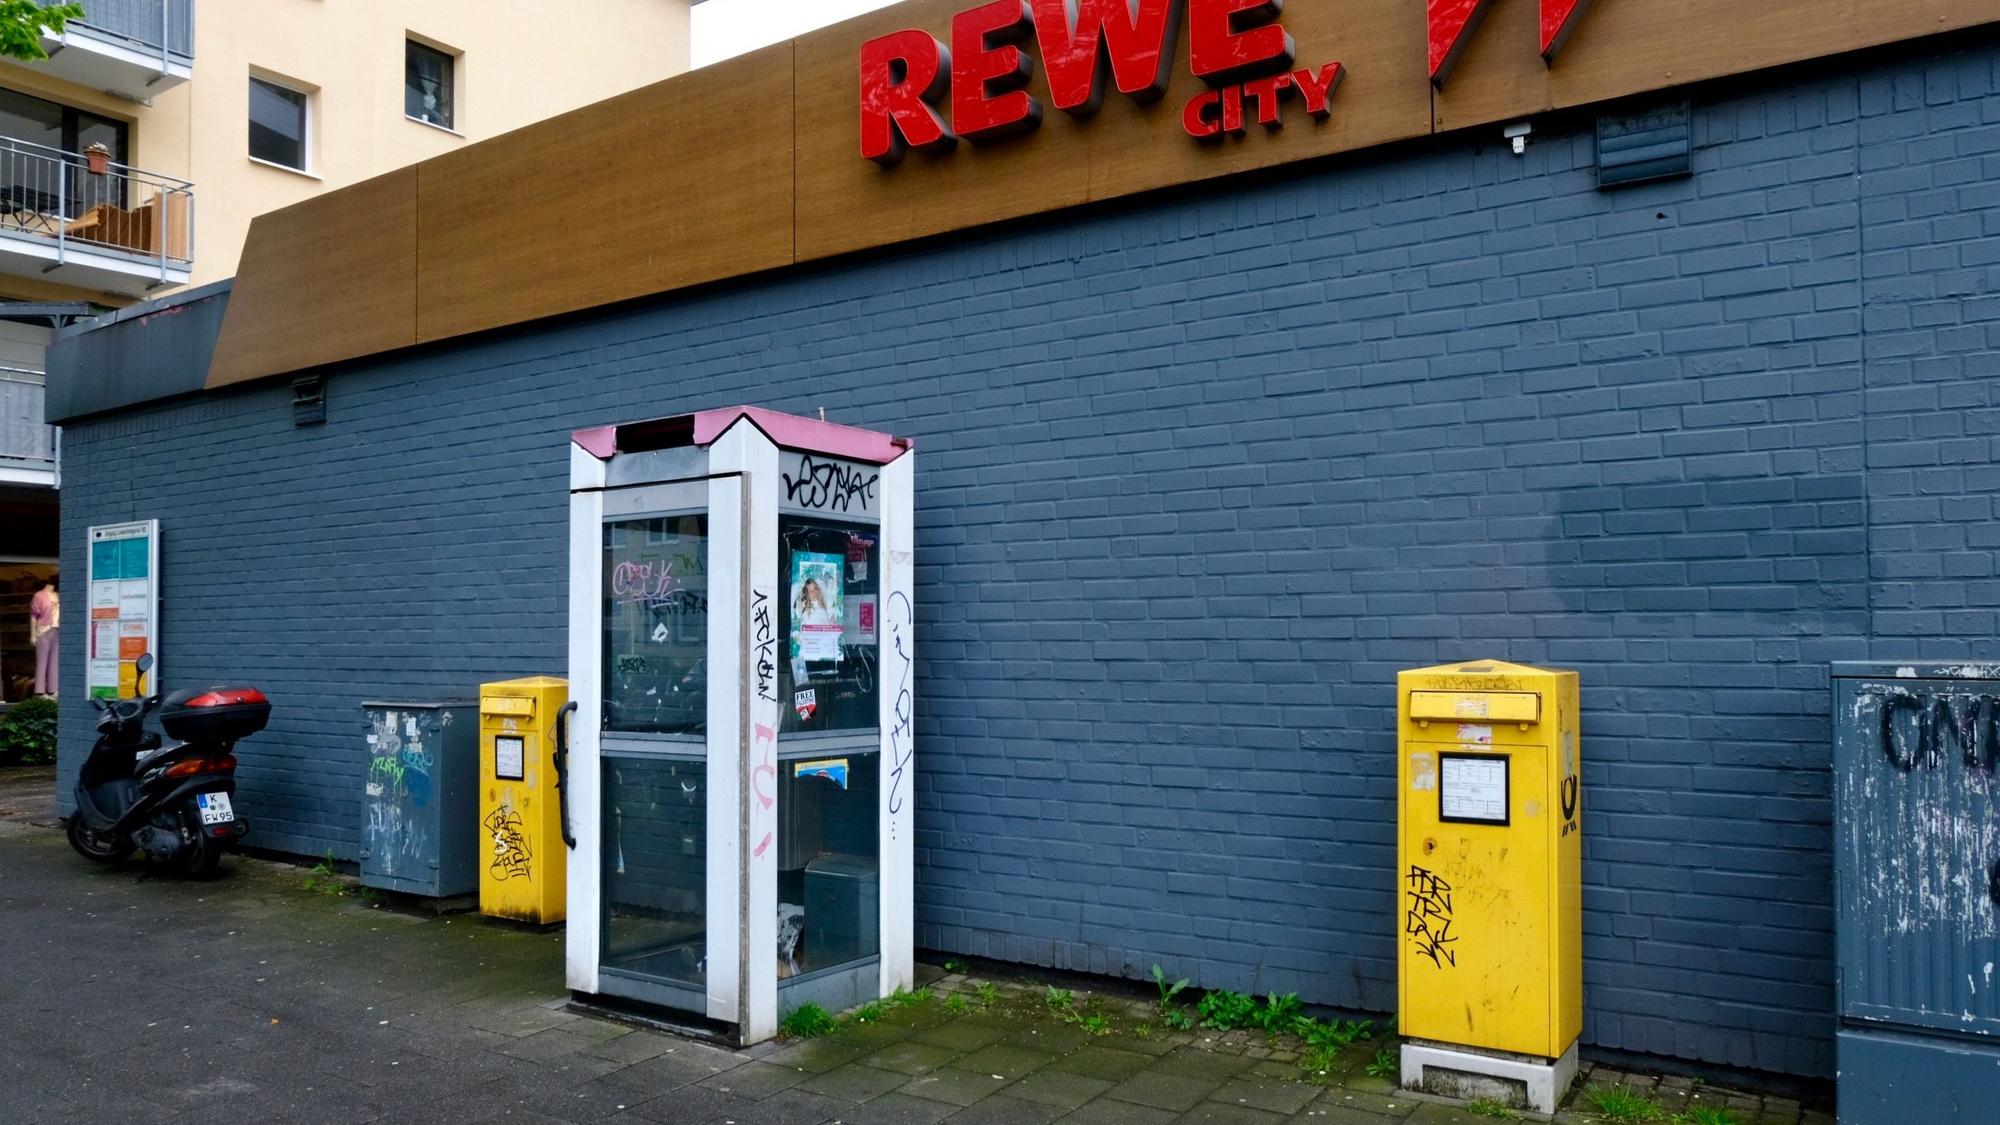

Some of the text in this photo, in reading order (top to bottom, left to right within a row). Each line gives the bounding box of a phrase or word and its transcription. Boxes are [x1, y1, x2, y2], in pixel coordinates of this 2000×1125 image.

[860, 0, 1290, 162] REWE
[1182, 61, 1344, 138] CITY
[796, 690, 814, 701] FREE
[210, 794, 216, 803] K
